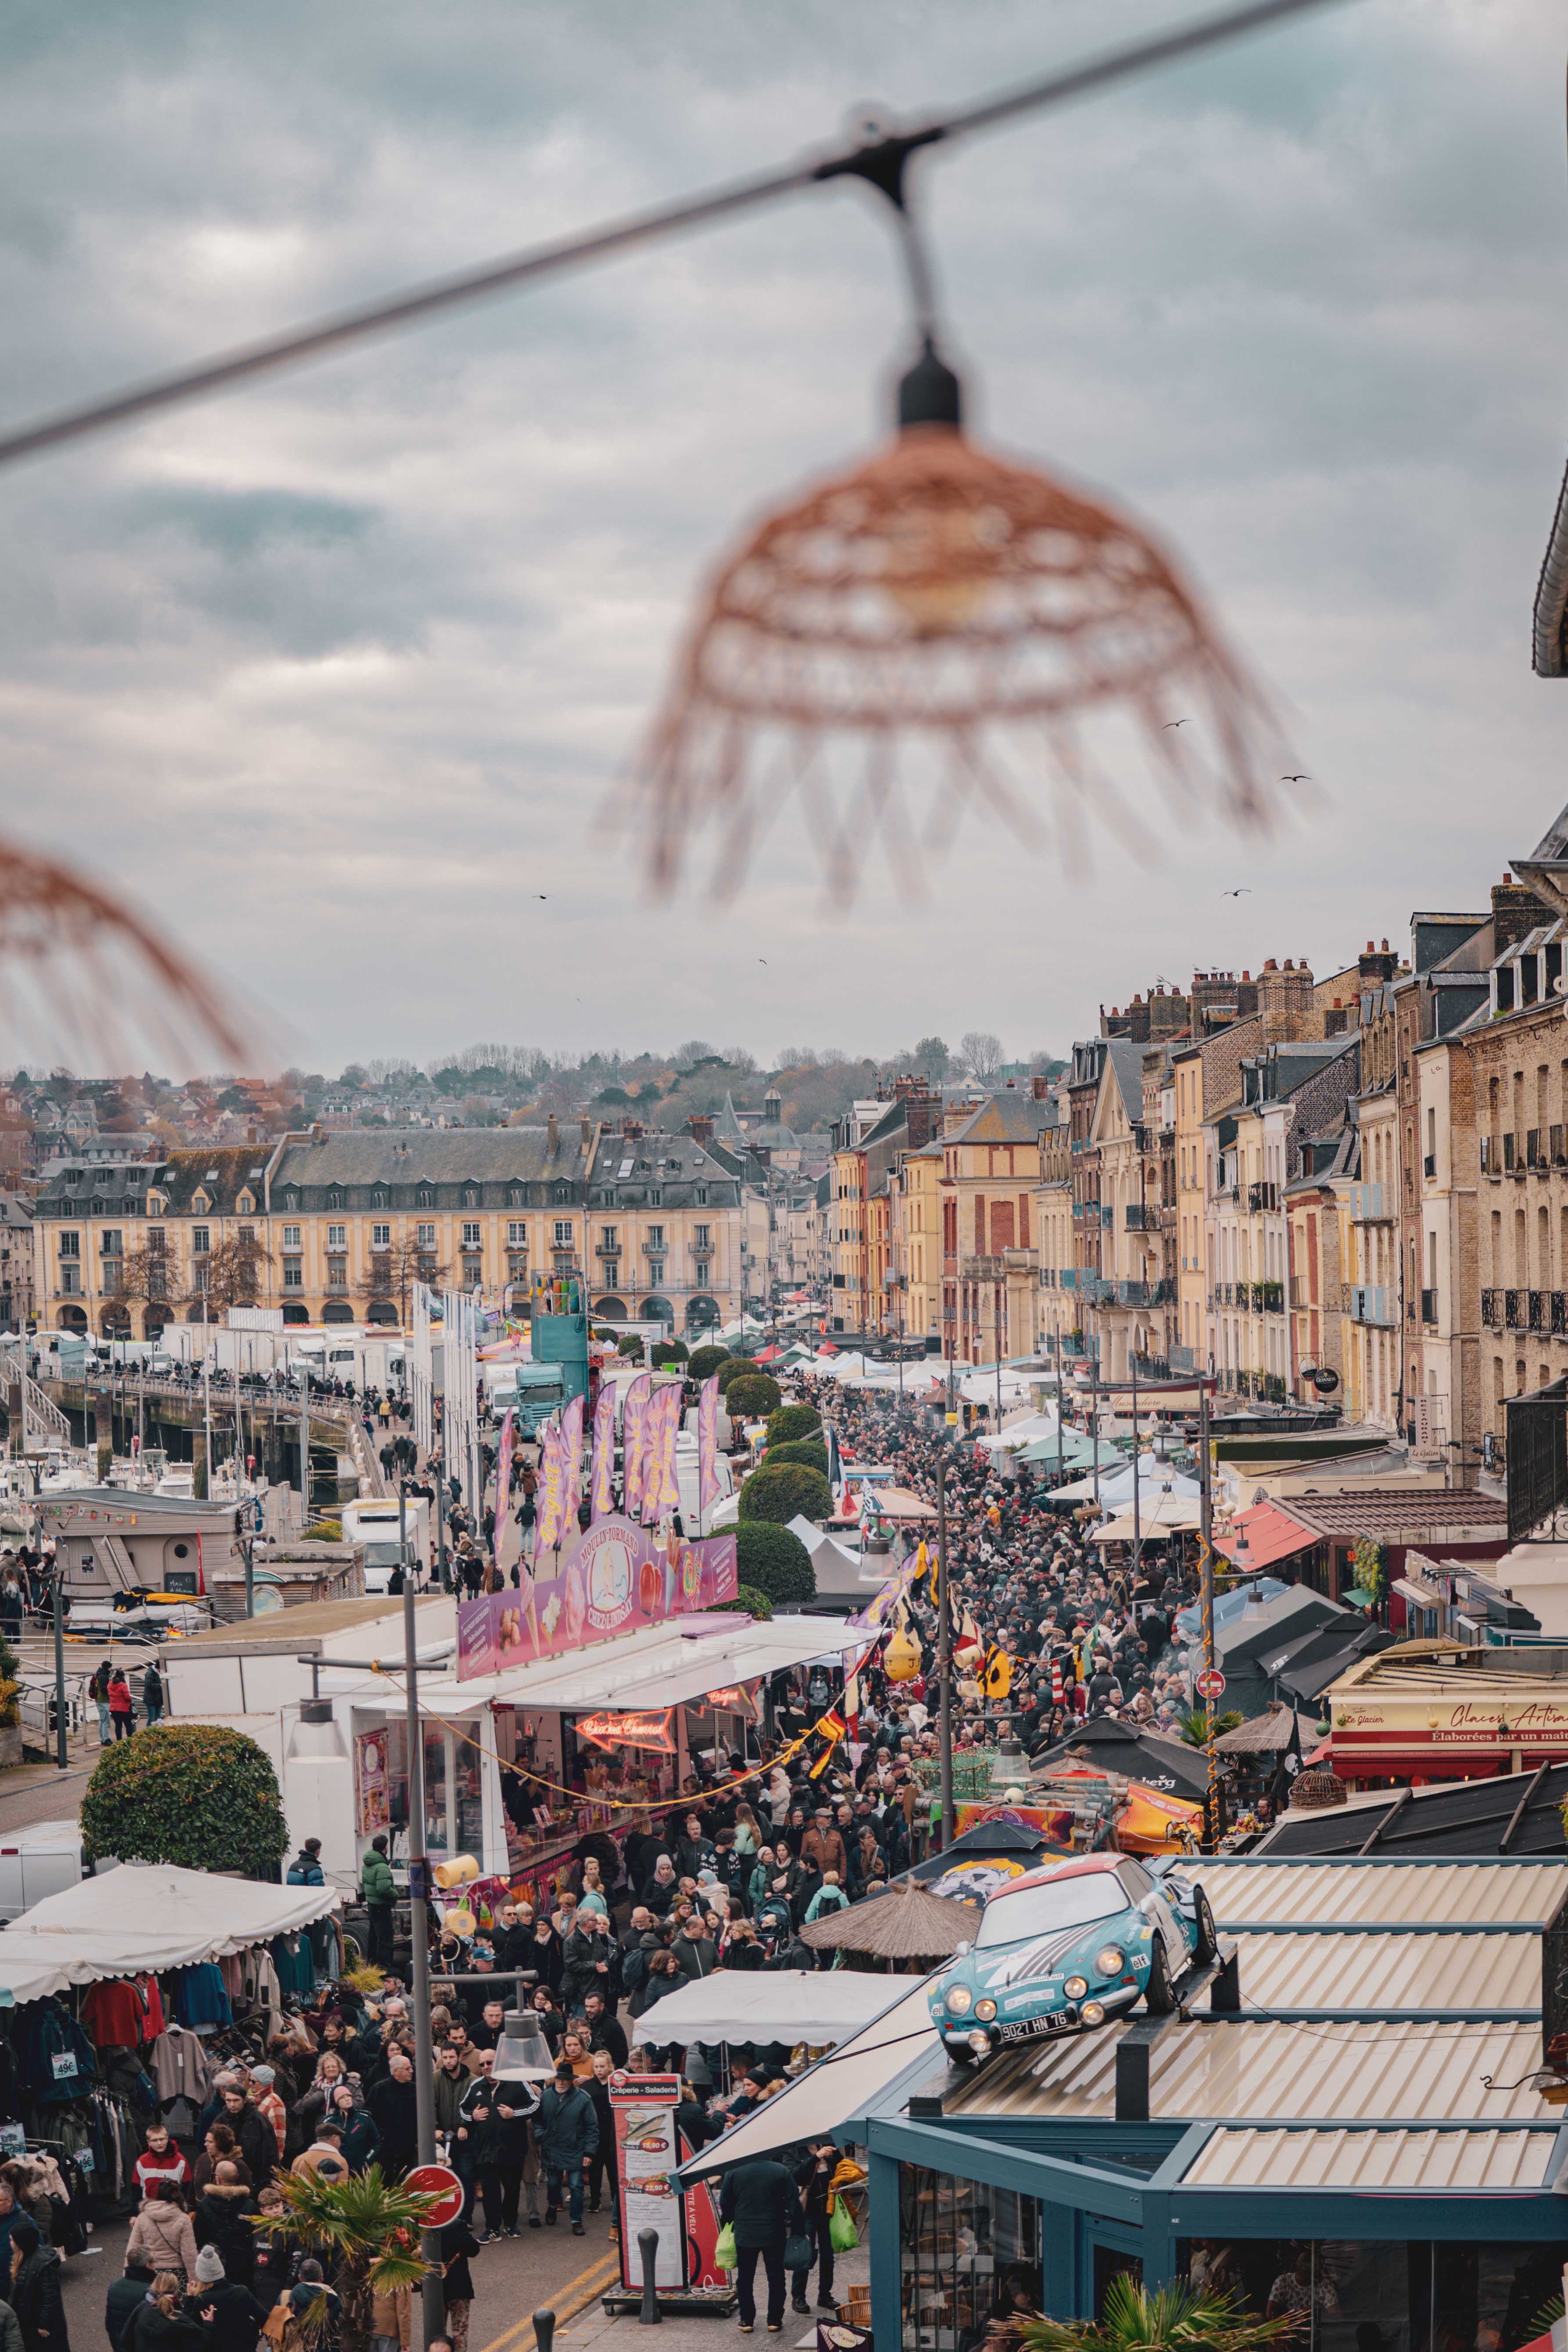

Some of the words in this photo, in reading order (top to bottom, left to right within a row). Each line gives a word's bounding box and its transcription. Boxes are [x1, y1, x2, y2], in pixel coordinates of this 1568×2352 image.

[1420, 1399, 1428, 1444] RESTAURANT
[540, 1459, 563, 1545] Beignet
[581, 1529, 606, 1566] MOULIN
[588, 1607, 605, 1629] CHEZ
[606, 1599, 633, 1629] LINDSAY
[1357, 1715, 1385, 1726] Glacier
[1450, 1703, 1503, 1727] Glaces
[1432, 1731, 1492, 1741] Élaborées
[1496, 1733, 1517, 1742] par
[1133, 1955, 1147, 1968] elf
[995, 1983, 1019, 1996] Alpine
[1020, 1976, 1050, 1986] Renault
[1002, 2022, 1029, 2039] 9027
[1033, 2018, 1048, 2033] HN
[1051, 2013, 1067, 2027] 76
[58, 2062, 74, 2074] 49€
